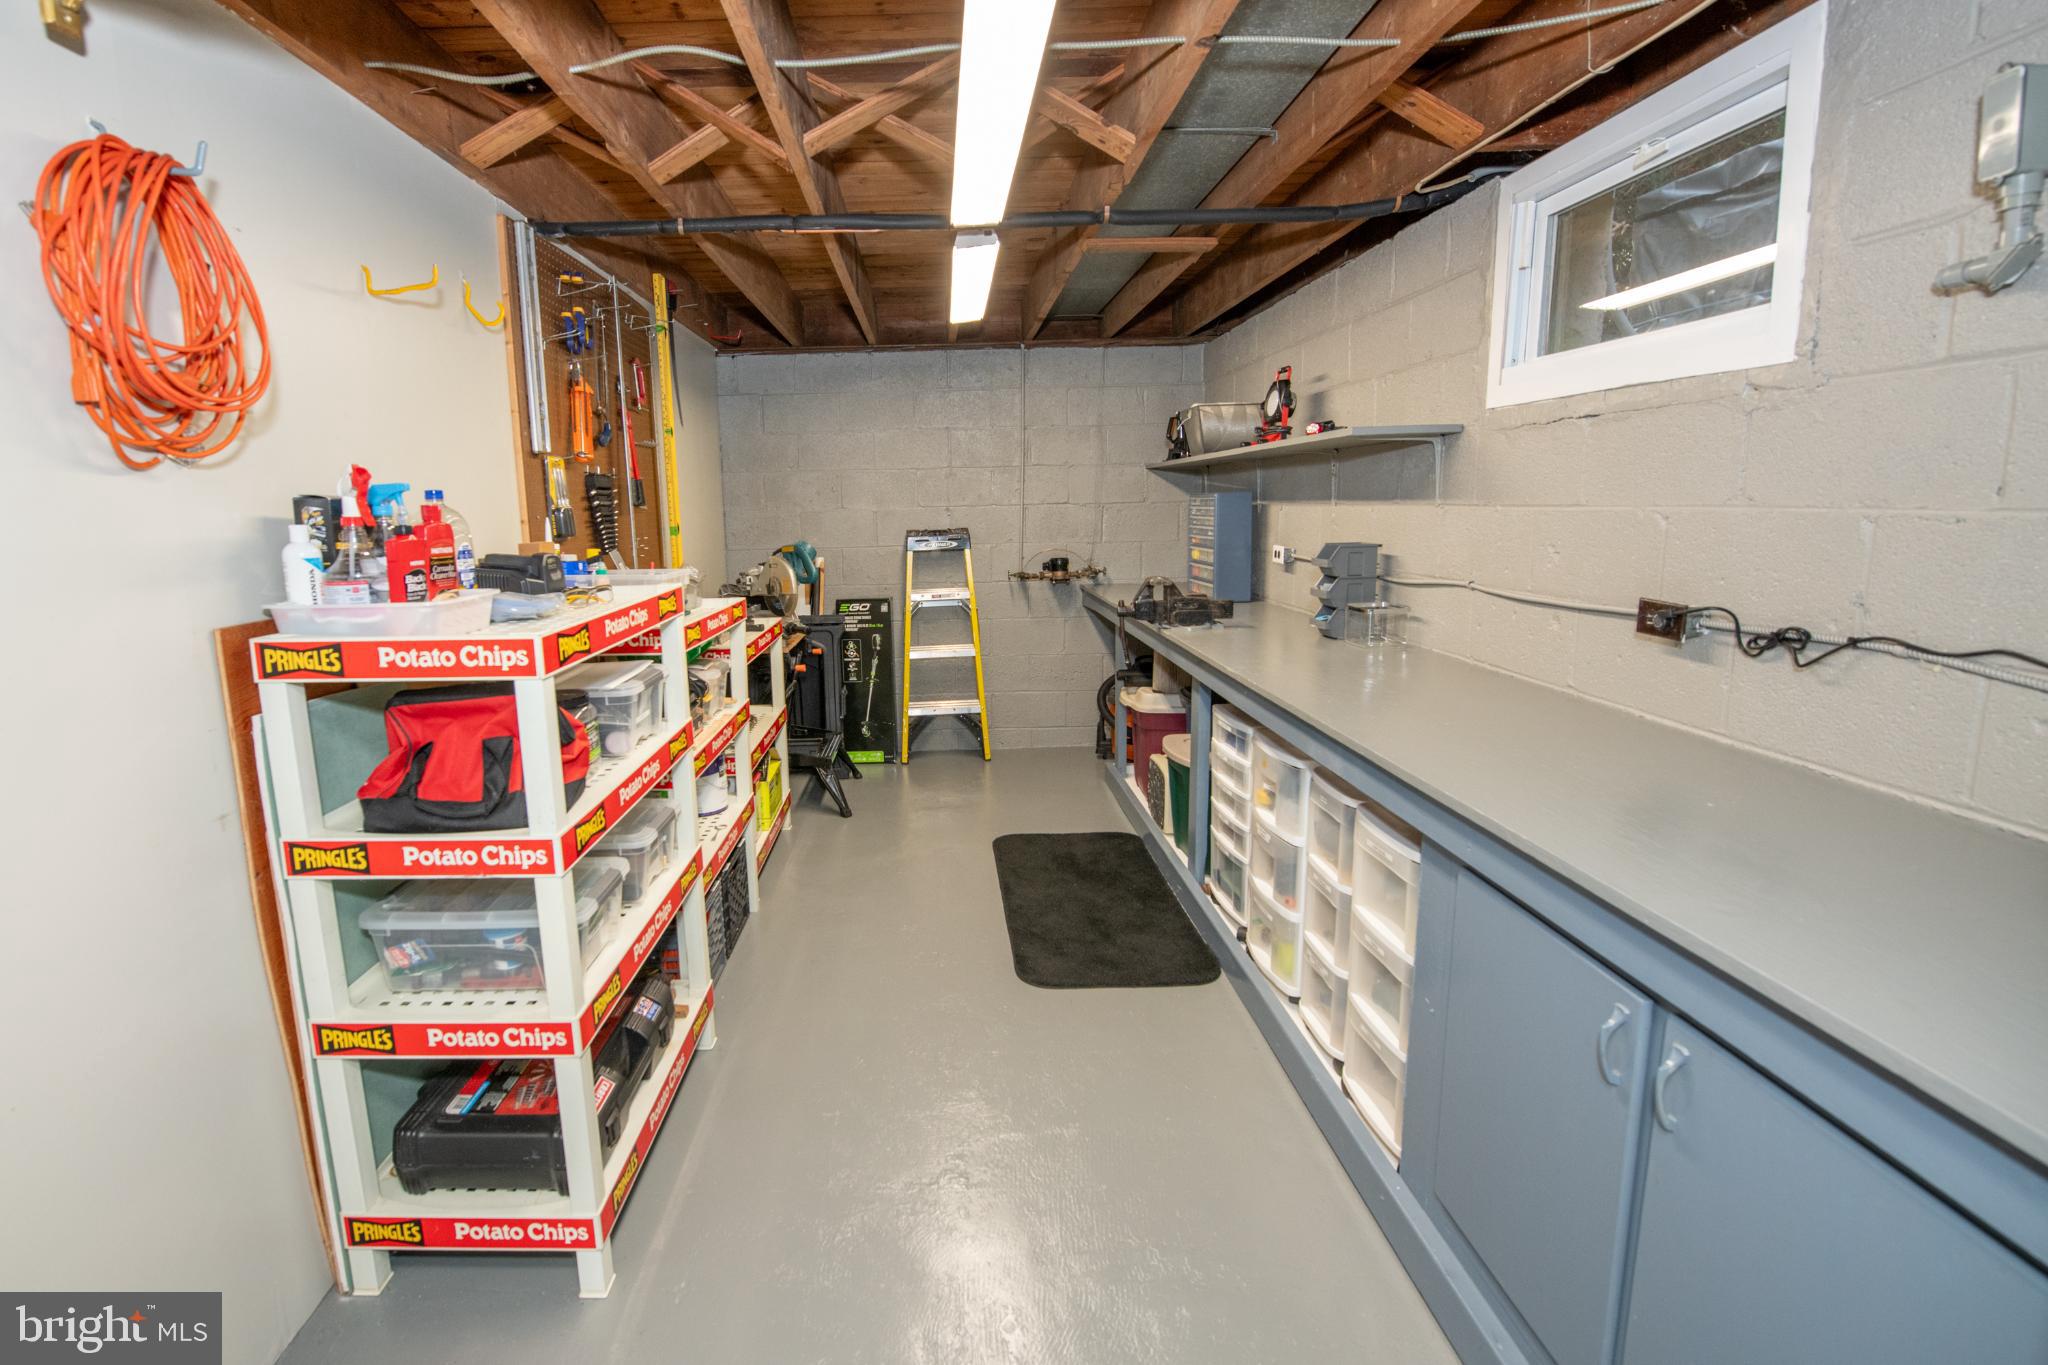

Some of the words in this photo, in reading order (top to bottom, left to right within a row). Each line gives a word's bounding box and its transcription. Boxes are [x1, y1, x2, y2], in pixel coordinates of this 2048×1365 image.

[309, 568, 319, 605] HONDA
[839, 603, 870, 612] EGO
[604, 614, 631, 637] Potato
[629, 607, 649, 626] Chips
[627, 633, 662, 650] Chip
[377, 646, 456, 668] Potato
[459, 644, 529, 671] Chips
[619, 776, 643, 806] Potato
[641, 759, 661, 784] Chips
[401, 846, 479, 866] Potato
[481, 845, 549, 870] Chips
[632, 929, 656, 963] Potato
[654, 901, 673, 930] Chips
[426, 1028, 500, 1047] Potato
[502, 1027, 568, 1051] Chips
[649, 1090, 670, 1132] Potato
[668, 1053, 686, 1089] Chips
[454, 1222, 525, 1241] Potato
[527, 1222, 590, 1245] Chips
